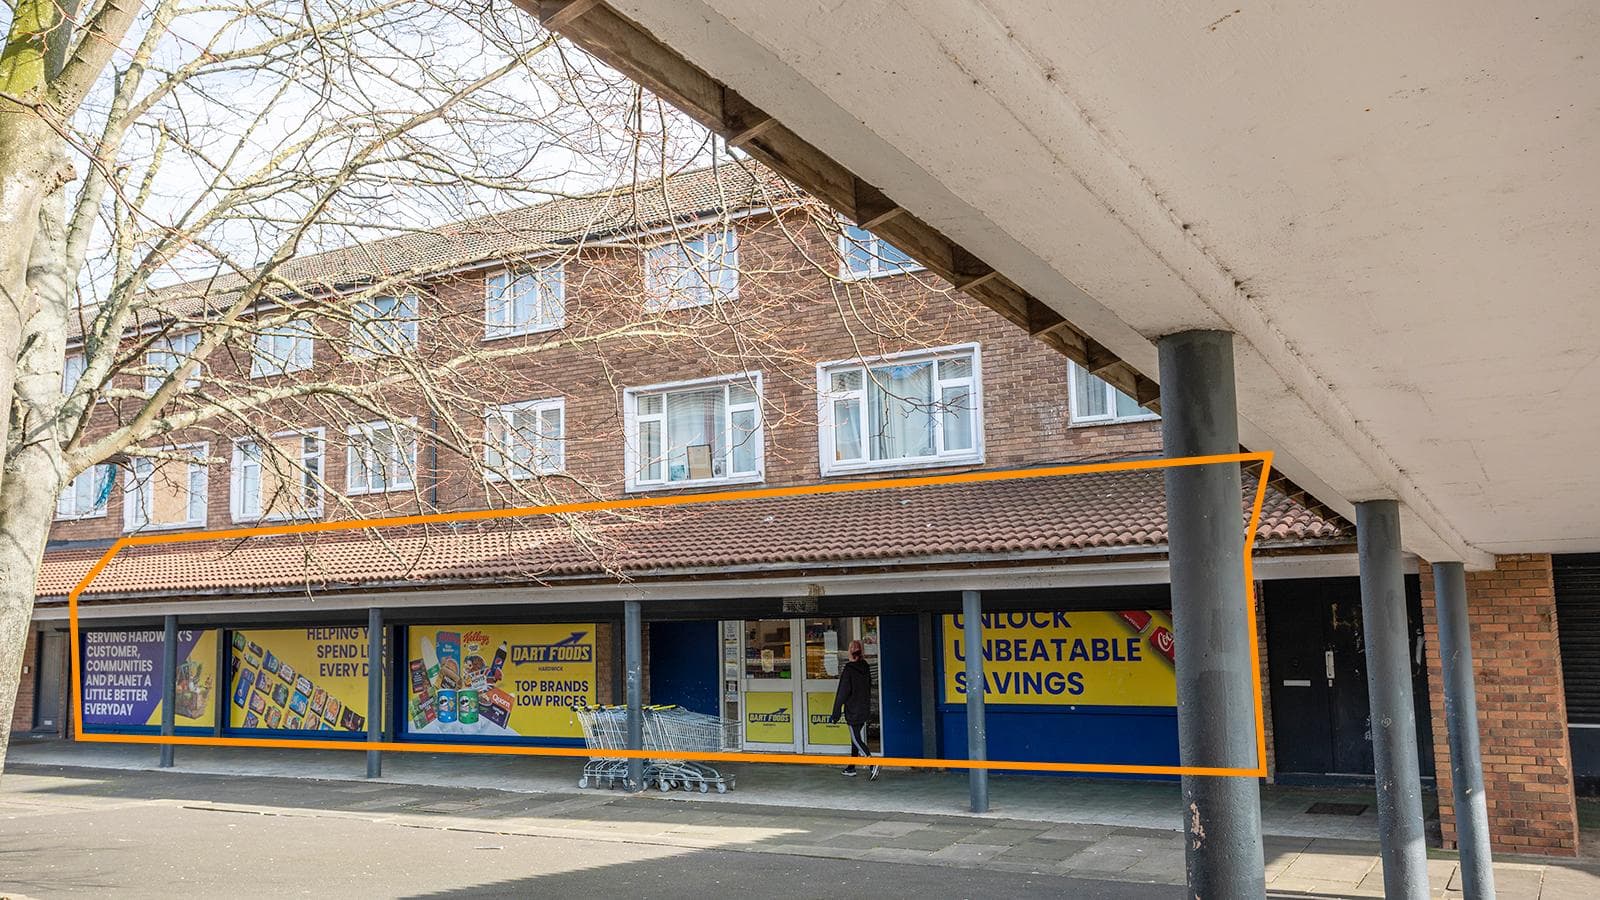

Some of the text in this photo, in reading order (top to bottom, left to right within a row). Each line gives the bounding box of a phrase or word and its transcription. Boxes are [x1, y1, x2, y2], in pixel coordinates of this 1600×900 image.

[87, 630, 193, 643] SERVING HARDWK'S
[307, 627, 359, 640] HELPING
[86, 645, 140, 659] CUSTOMER,
[317, 644, 358, 658] SPEND
[513, 646, 590, 661] DART FOODS
[86, 660, 153, 672] COMMUNITIES
[320, 663, 359, 677] EVERY
[85, 674, 152, 686] AND PLANET A
[515, 680, 589, 692] TOP BRANDS
[85, 688, 148, 701] LITTLE BETTER
[517, 695, 587, 707] LOW PRICES
[84, 702, 133, 716] EVERYDAY
